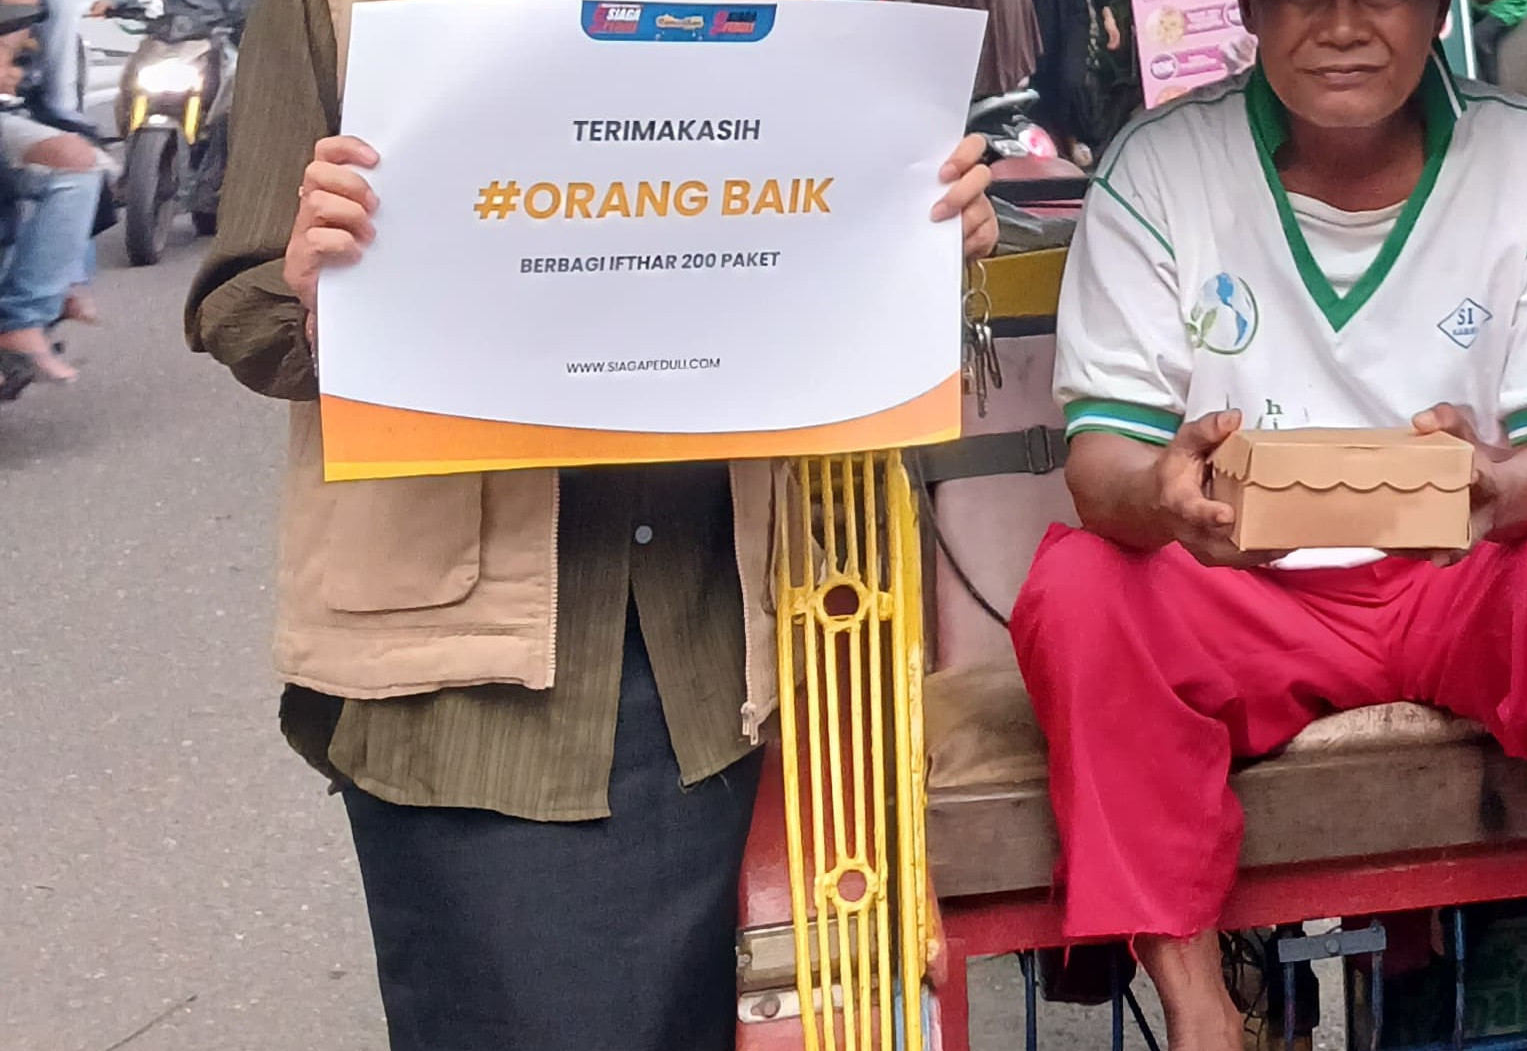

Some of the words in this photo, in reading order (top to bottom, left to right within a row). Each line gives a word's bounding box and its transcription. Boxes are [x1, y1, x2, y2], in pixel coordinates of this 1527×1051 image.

[573, 119, 761, 142] TERIMAKASIH
[473, 180, 709, 220] #ORANG
[721, 177, 834, 217] BAIK
[520, 256, 606, 274] BERBAGI
[608, 254, 677, 272] IFTHAR
[681, 253, 717, 269] 200
[720, 251, 781, 268] PAKET
[566, 358, 721, 374] WWW.SIAGAPEDULI.COM
